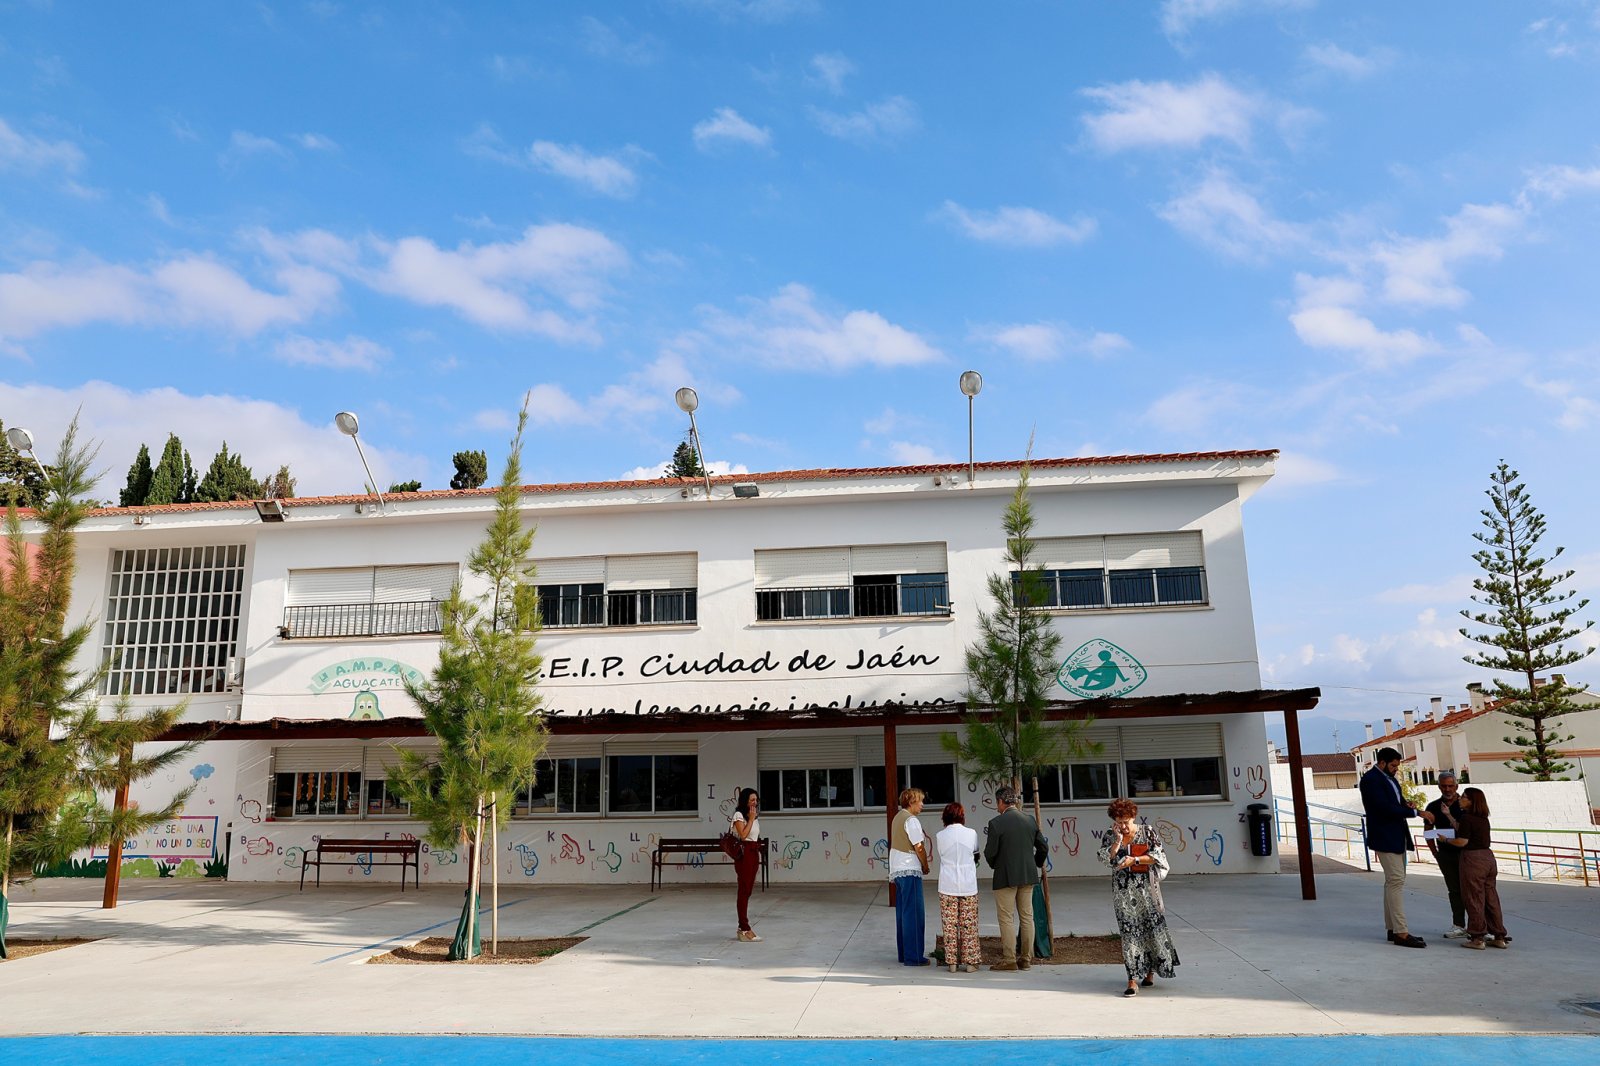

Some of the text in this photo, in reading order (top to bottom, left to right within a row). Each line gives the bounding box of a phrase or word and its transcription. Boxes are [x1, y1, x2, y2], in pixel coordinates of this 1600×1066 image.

[640, 651, 780, 678] Ciudad
[788, 649, 836, 673] de
[846, 645, 940, 670] Jaén
[333, 679, 400, 689] AGUACATE
[1233, 767, 1240, 777] U
[707, 784, 715, 799] I
[968, 782, 977, 792] O
[1238, 813, 1245, 822] Z
[1047, 818, 1054, 828] V
[187, 824, 204, 834] UNA
[1188, 827, 1197, 840] Y
[240, 836, 247, 845] B
[547, 831, 555, 842] K
[630, 833, 640, 842] LL
[821, 831, 829, 841] P
[156, 839, 168, 848] NO
[170, 839, 182, 848] UN
[186, 839, 211, 848] DSEO
[507, 842, 513, 851] J
[588, 840, 595, 851] L
[771, 841, 778, 852] Ñ
[860, 837, 869, 847] Q
[276, 846, 283, 855] C
[421, 844, 429, 853] G
